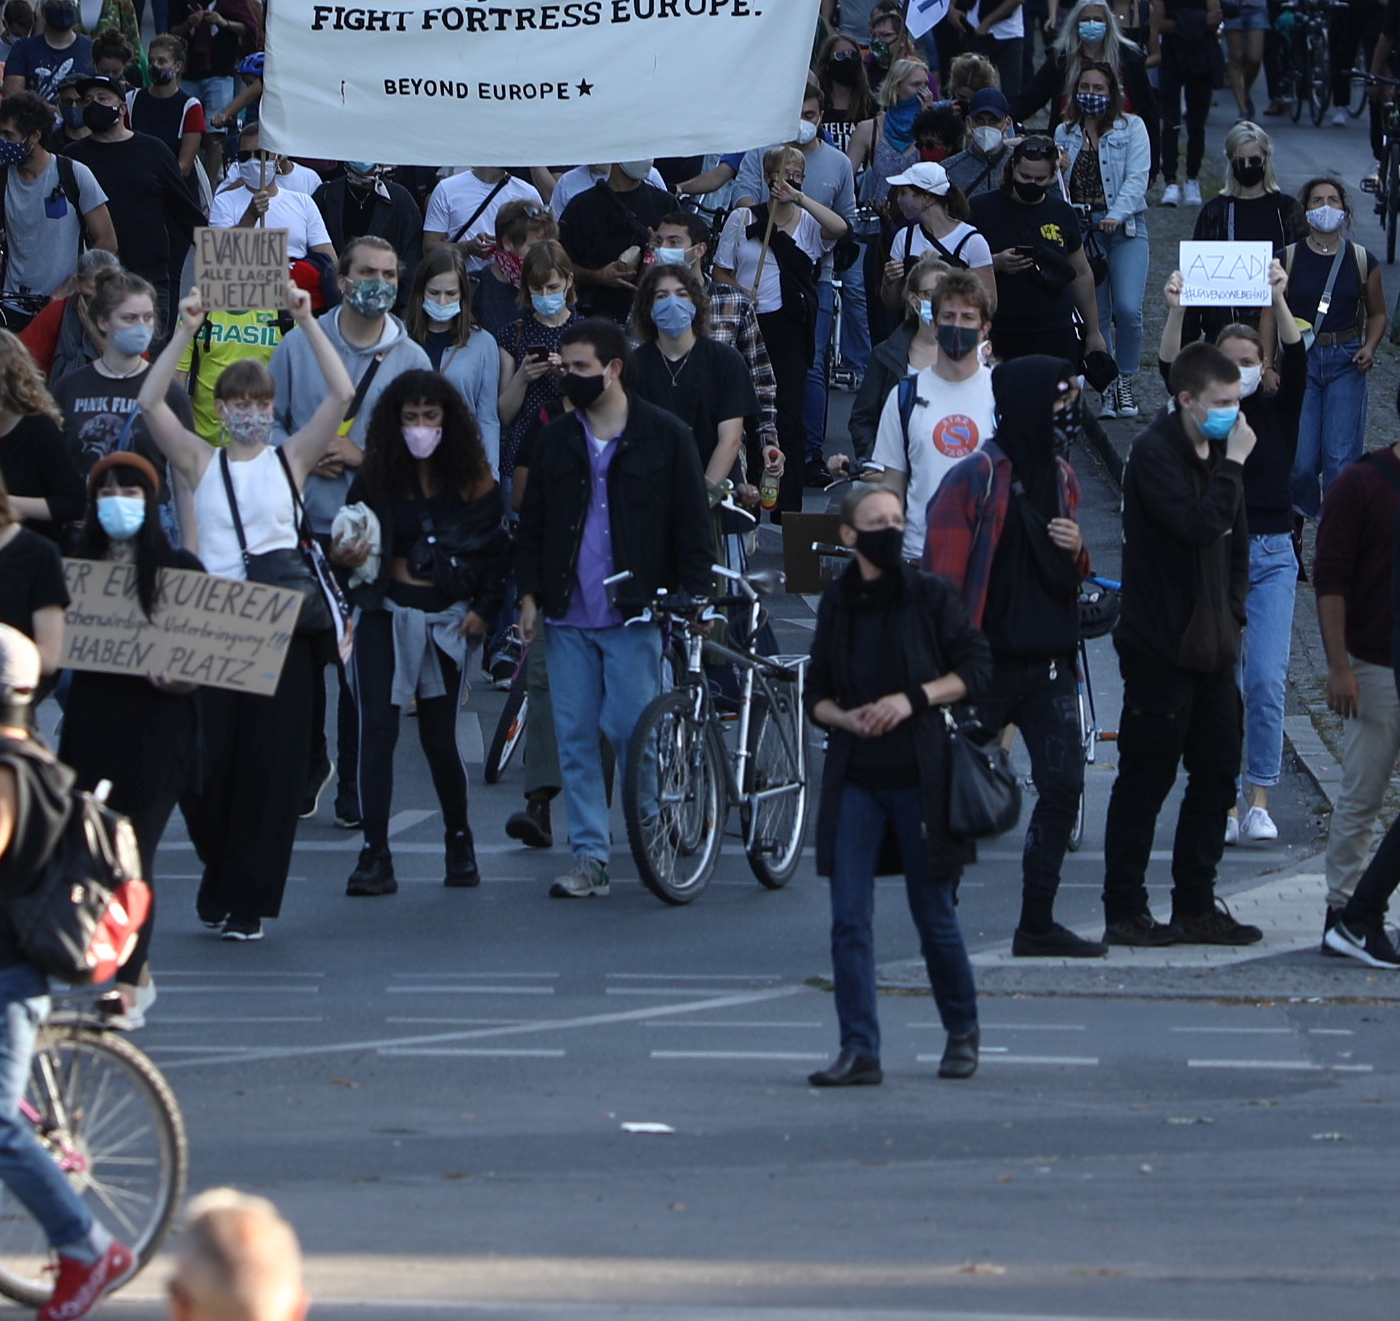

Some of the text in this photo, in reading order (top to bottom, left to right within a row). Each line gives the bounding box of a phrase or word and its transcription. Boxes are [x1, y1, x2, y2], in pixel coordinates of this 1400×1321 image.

[311, 5, 414, 31] FIGHT
[421, 1, 602, 32] FORTRESS
[384, 78, 570, 100] BEYOND EUROPE
[202, 230, 286, 267] EVAKUIERT
[201, 269, 283, 285] ALLE LAGER
[74, 397, 109, 413] PINK
[103, 565, 295, 625] EVKUIEREN
[67, 635, 255, 686] HABEN PLATZ
